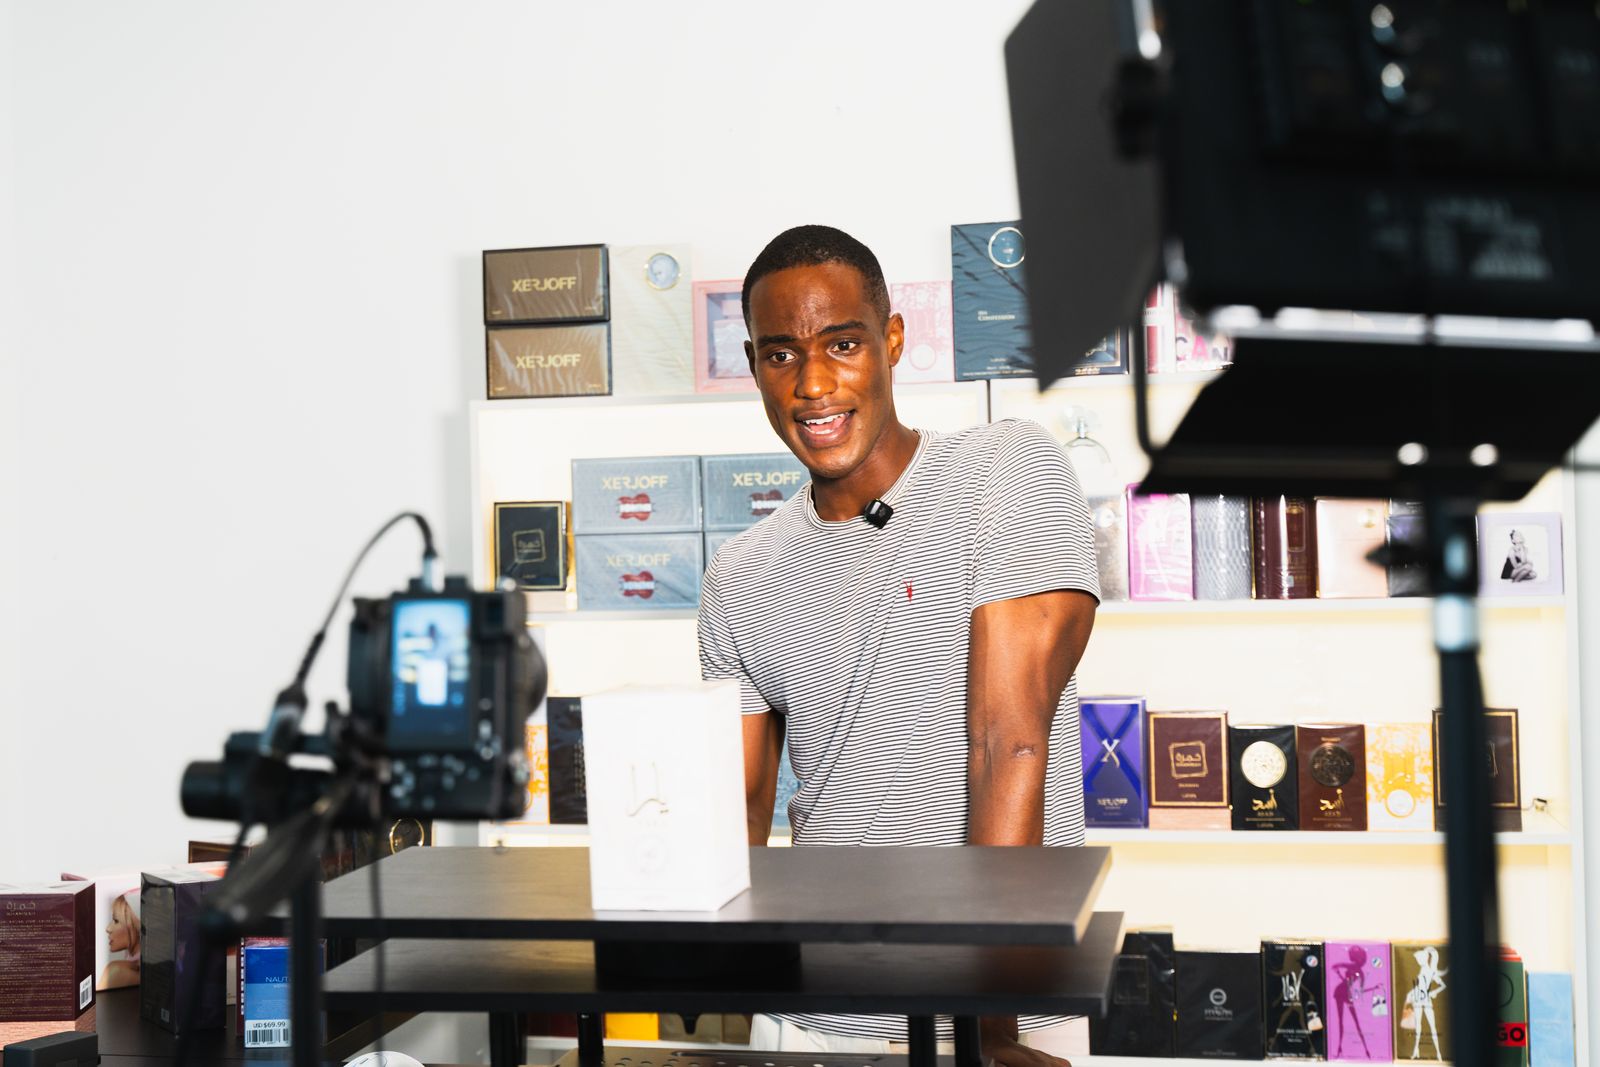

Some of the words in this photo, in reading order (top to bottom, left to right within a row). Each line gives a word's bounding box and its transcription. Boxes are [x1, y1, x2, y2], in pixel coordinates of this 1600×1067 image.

[511, 276, 577, 293] XERJOFF
[515, 353, 581, 369] XERJOFF
[601, 474, 669, 491] XERJOFF
[732, 470, 802, 488] XERJOFF
[606, 552, 672, 568] XERJOFF
[263, 1021, 286, 1029] $69.99
[1497, 1026, 1525, 1043] GO
